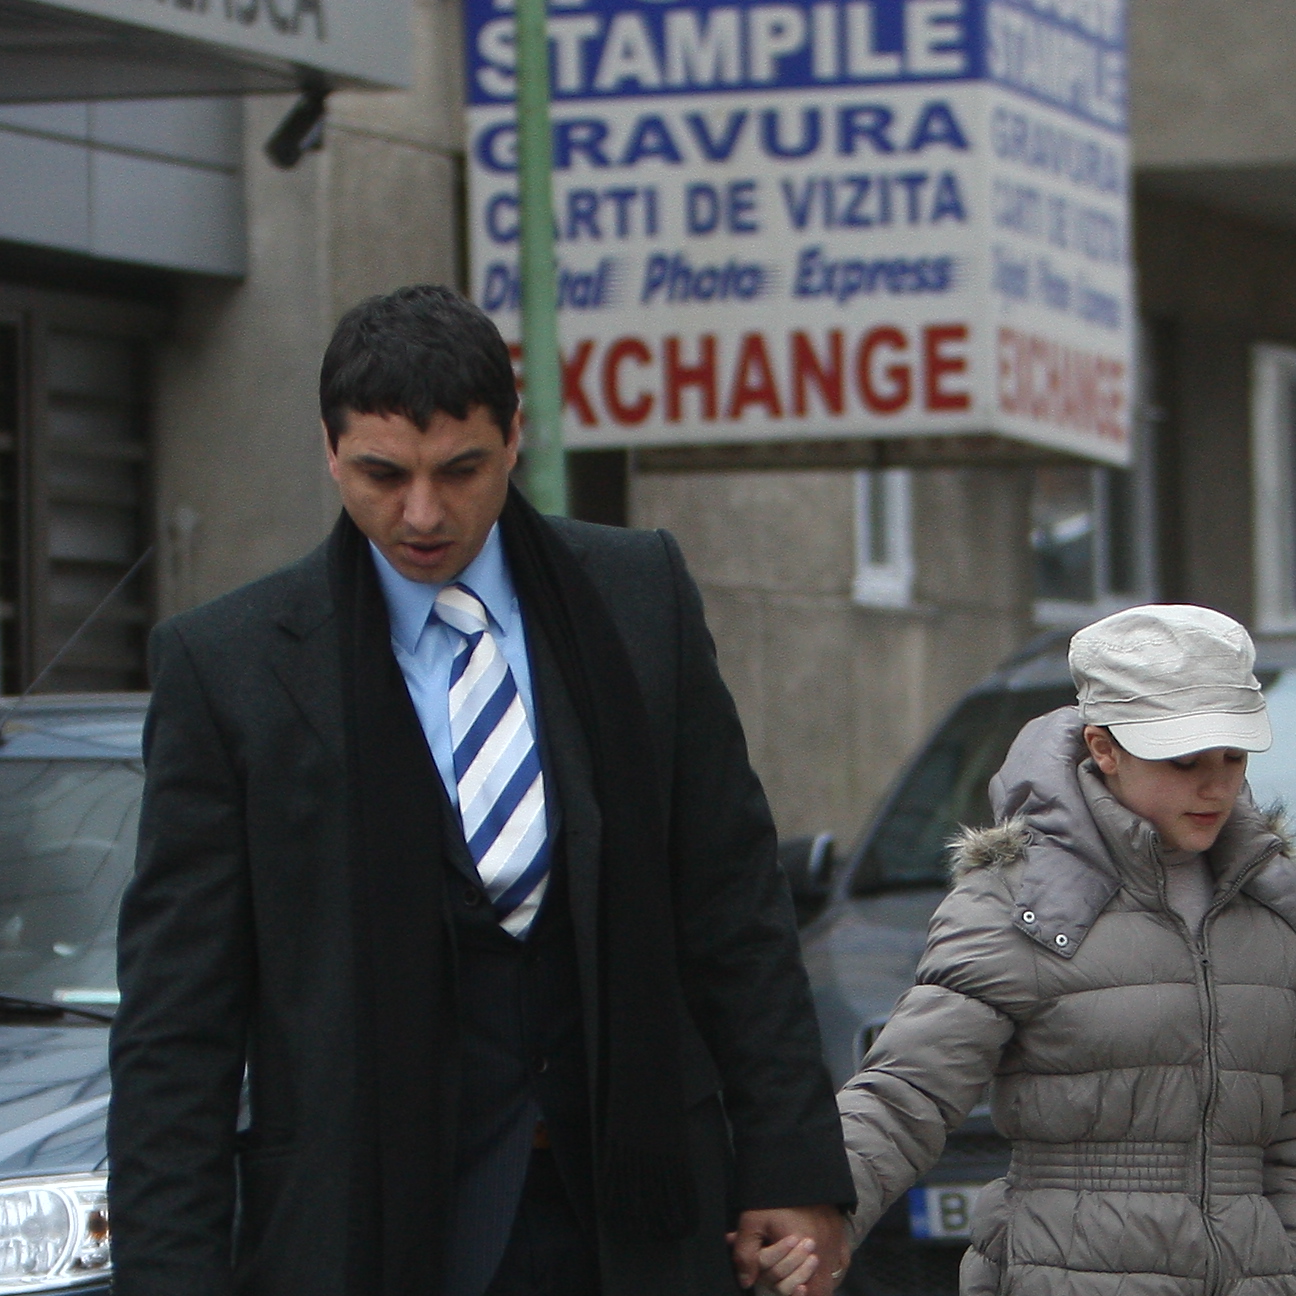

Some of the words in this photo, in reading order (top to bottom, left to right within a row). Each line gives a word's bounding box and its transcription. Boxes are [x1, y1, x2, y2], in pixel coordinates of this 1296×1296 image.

[476, 2, 965, 97] STAMPILE
[473, 102, 970, 173] GRAVURA
[485, 182, 659, 243] CRTI
[685, 180, 758, 236] DE
[781, 169, 968, 231] VIZITA
[641, 252, 764, 304] Photo
[793, 246, 953, 304] Express
[508, 324, 971, 427] XCHANGE
[940, 1192, 969, 1231] B
